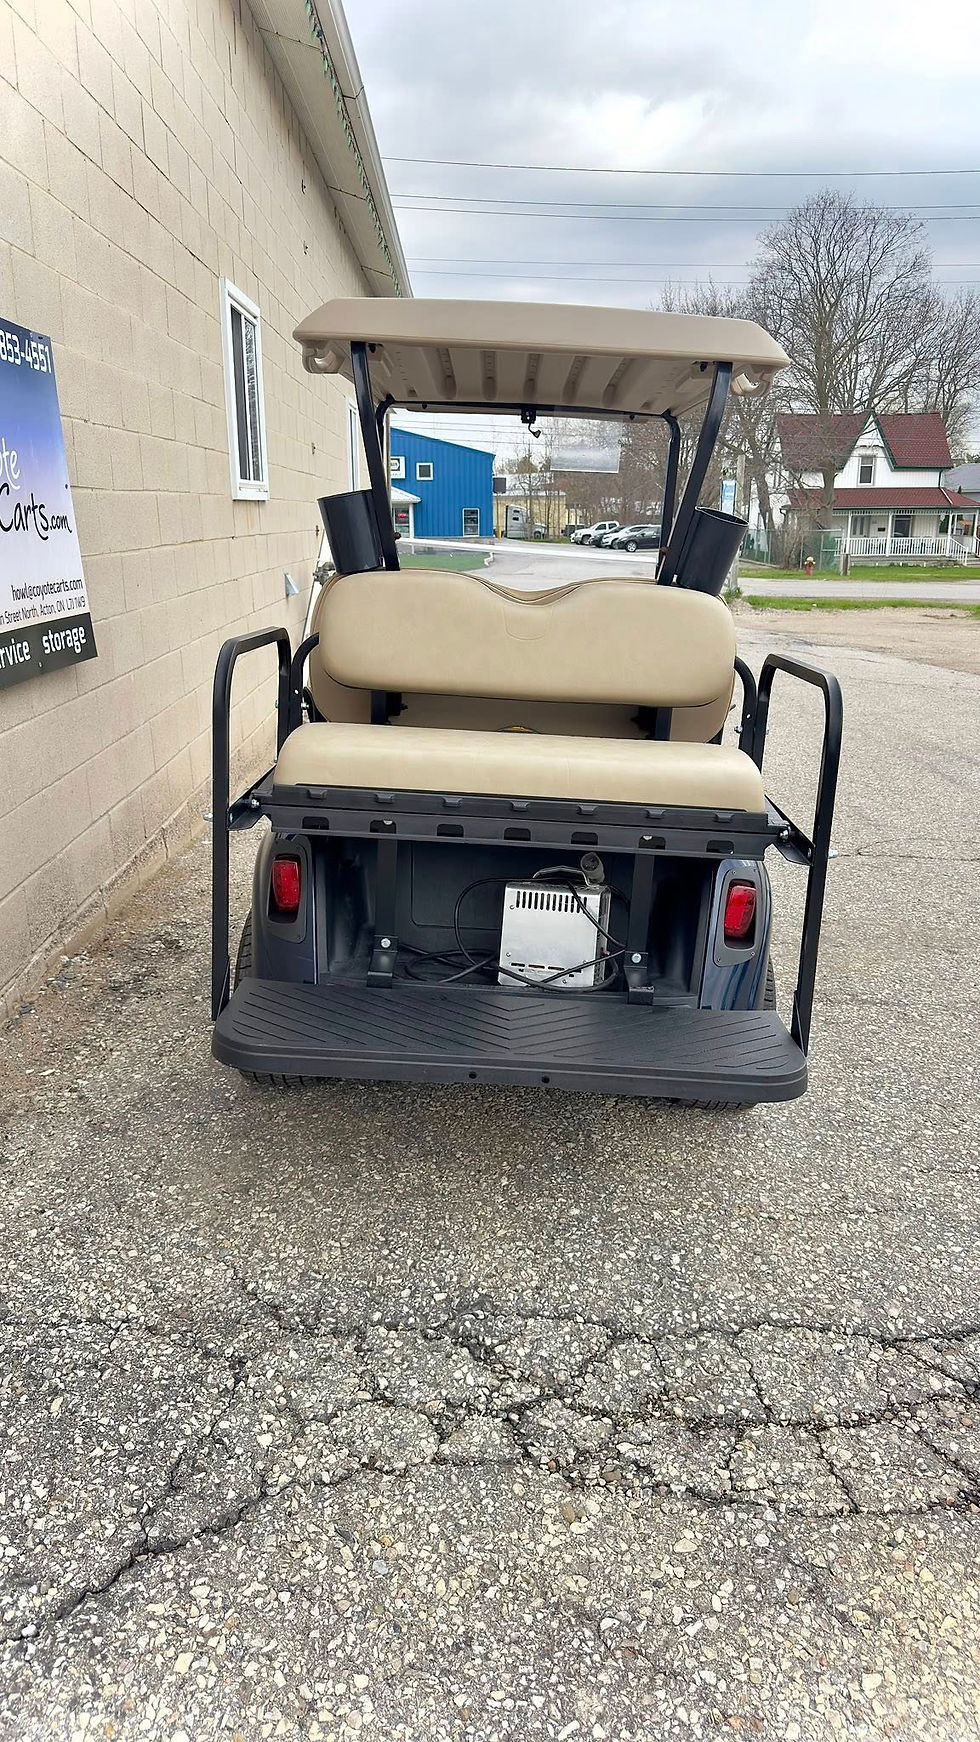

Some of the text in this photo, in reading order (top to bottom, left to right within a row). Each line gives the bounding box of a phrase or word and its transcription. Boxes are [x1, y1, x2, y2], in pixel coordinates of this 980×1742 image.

[11, 579, 84, 601] howl@coyotecarts.com
[4, 610, 22, 625] Street
[56, 600, 65, 613] ON
[0, 627, 87, 669] rvice storage
